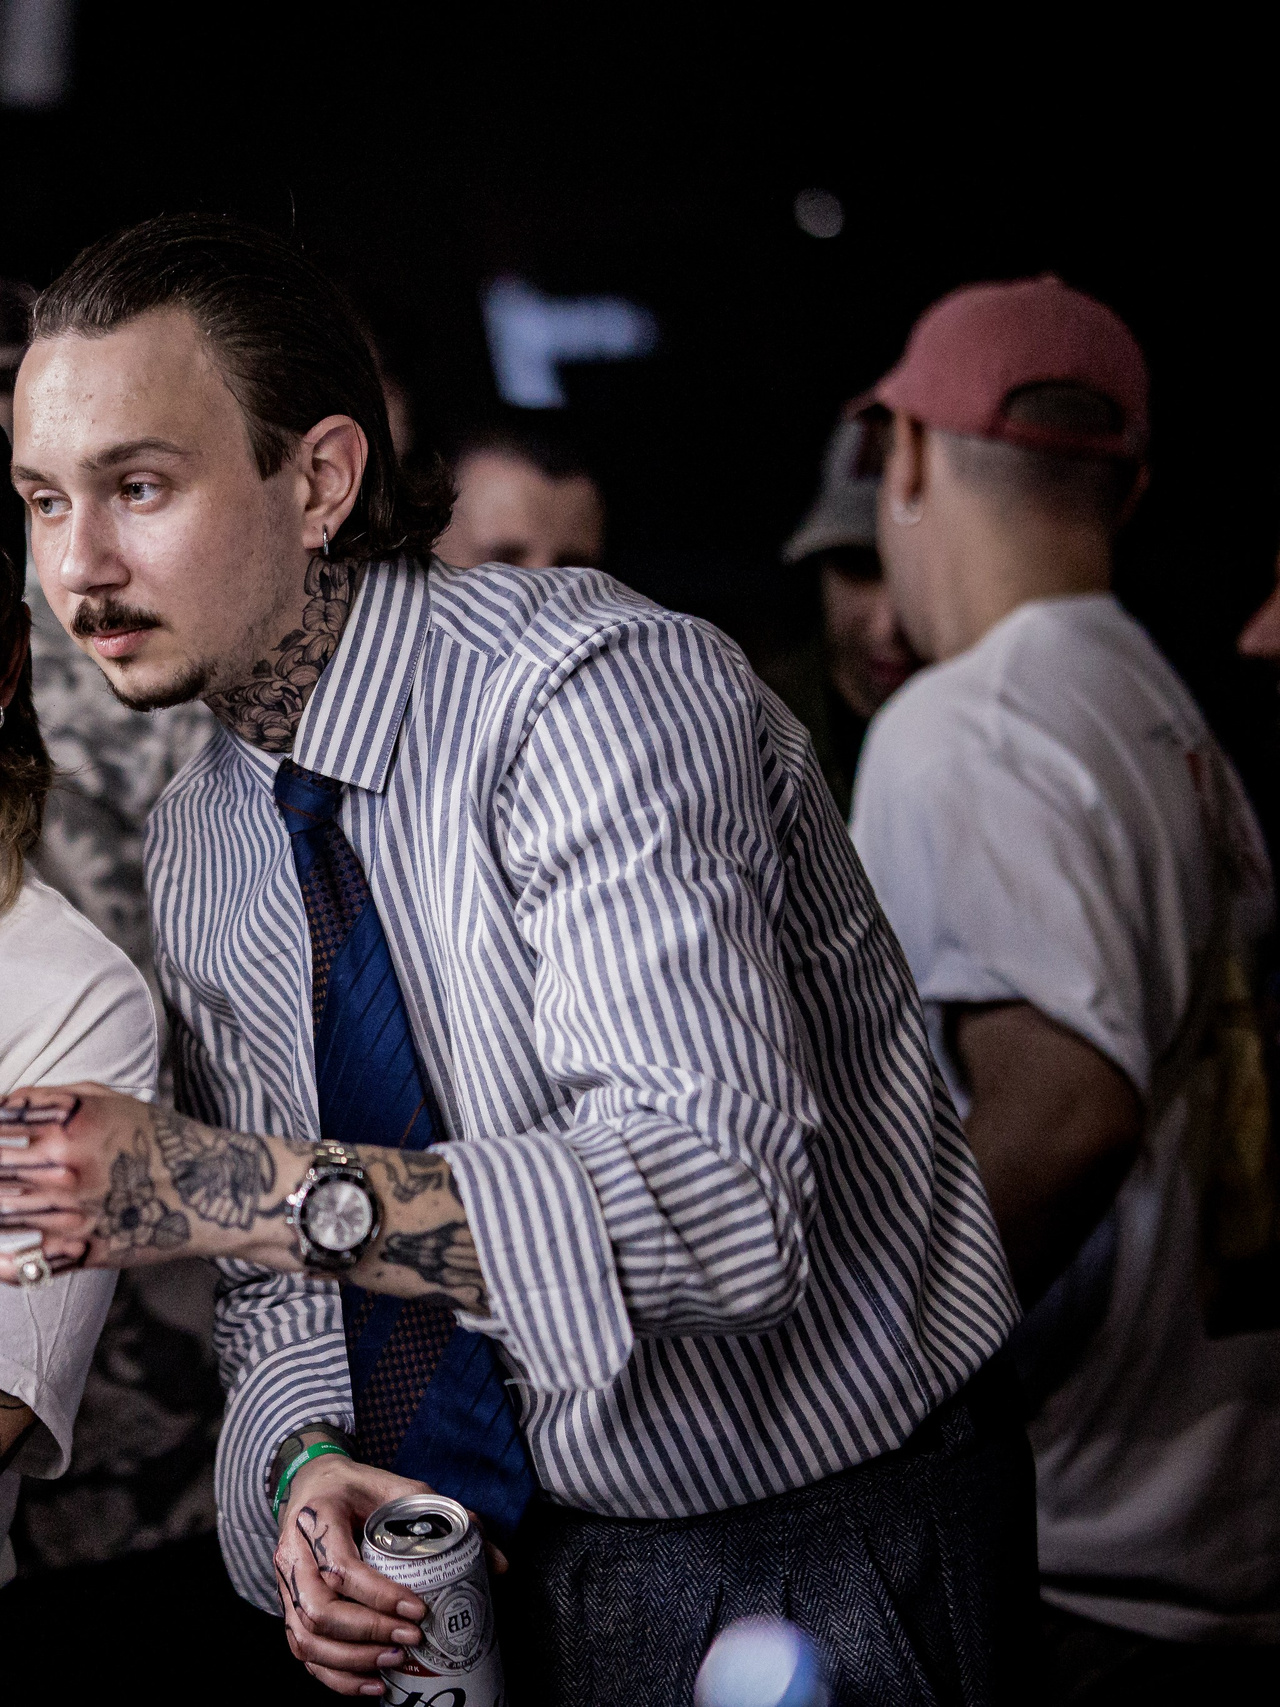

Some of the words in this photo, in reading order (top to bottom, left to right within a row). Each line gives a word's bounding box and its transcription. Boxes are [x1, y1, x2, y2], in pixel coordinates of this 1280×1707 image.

[385, 1563, 405, 1571] brewer
[407, 1559, 426, 1568] which
[423, 1566, 443, 1577] Aging
[444, 1552, 468, 1569] produces
[414, 1580, 426, 1589] you
[428, 1573, 442, 1584] will
[442, 1570, 456, 1582] find
[448, 1610, 472, 1633] AB
